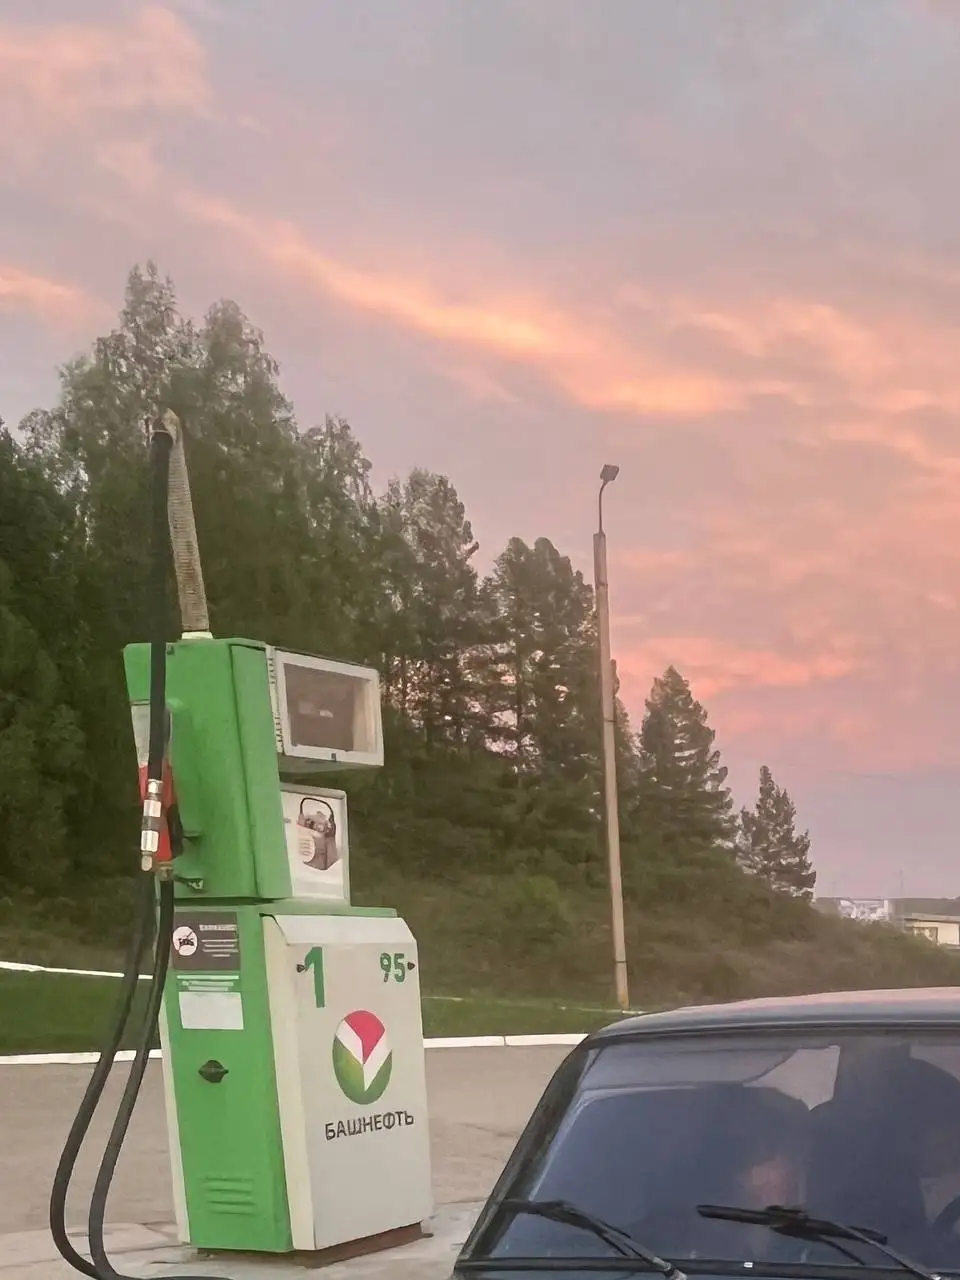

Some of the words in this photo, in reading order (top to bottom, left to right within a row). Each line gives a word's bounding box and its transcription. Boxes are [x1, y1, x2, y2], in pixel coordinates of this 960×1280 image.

[304, 946, 325, 1008] 1
[379, 952, 406, 983] 95
[325, 1110, 415, 1141] БАШНЕФТЬ
